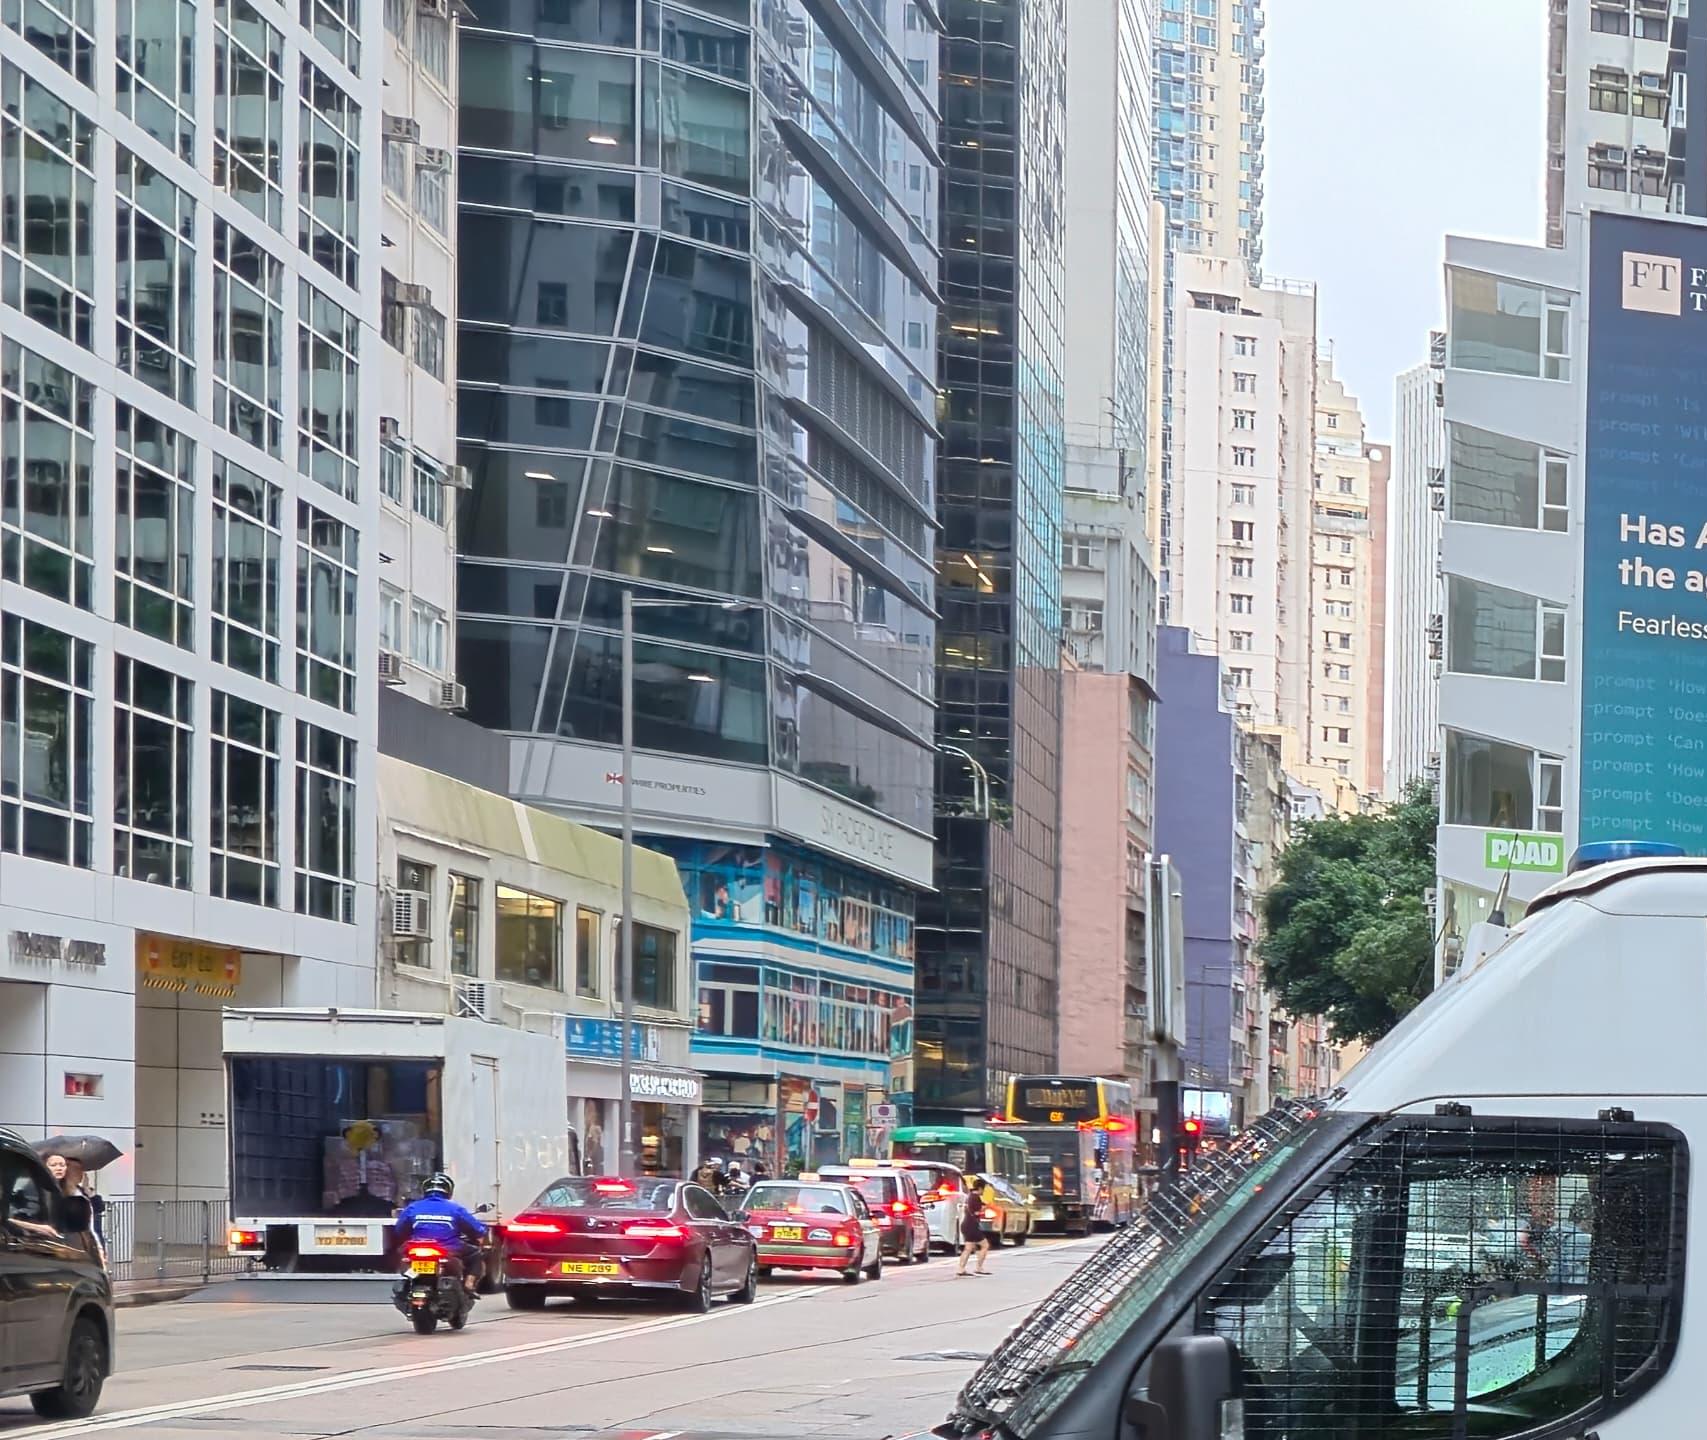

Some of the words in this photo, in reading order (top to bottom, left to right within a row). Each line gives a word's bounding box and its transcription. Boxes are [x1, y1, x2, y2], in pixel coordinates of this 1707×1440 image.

[1629, 259, 1678, 292] FT
[1620, 513, 1685, 548] Has
[1618, 556, 1675, 589] the
[1491, 839, 1558, 866] POAD
[567, 1263, 583, 1273] NE
